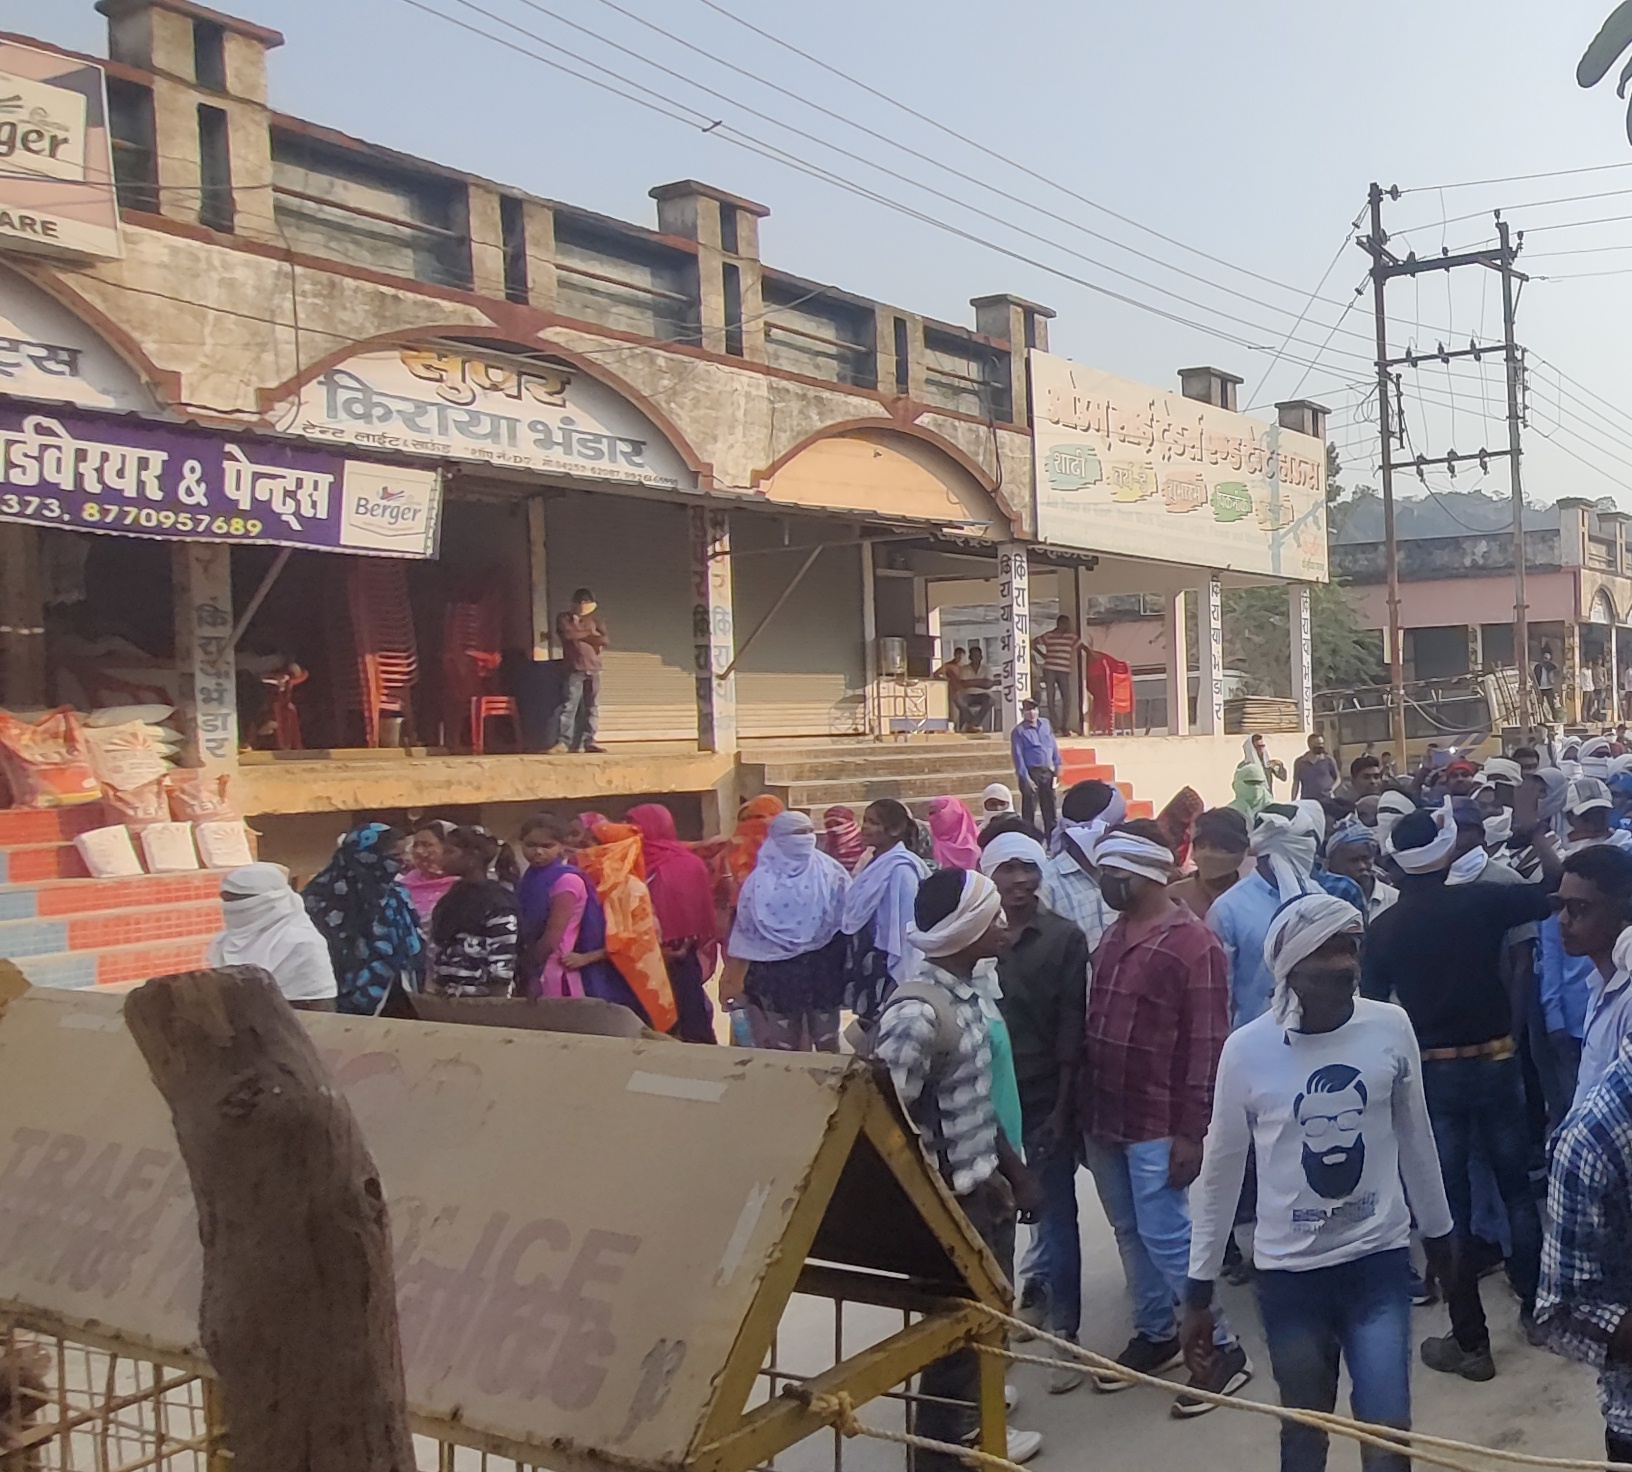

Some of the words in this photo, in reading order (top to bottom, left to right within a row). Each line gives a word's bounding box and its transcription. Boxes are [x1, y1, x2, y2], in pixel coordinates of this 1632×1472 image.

[0, 211, 59, 239] ARE
[317, 368, 521, 449] किराया
[527, 416, 647, 468] भंडार
[1053, 448, 1086, 478] शादी
[178, 459, 208, 507] &
[81, 502, 263, 536] 8770957689
[355, 496, 422, 524] Berger
[1013, 552, 1028, 636] किराया
